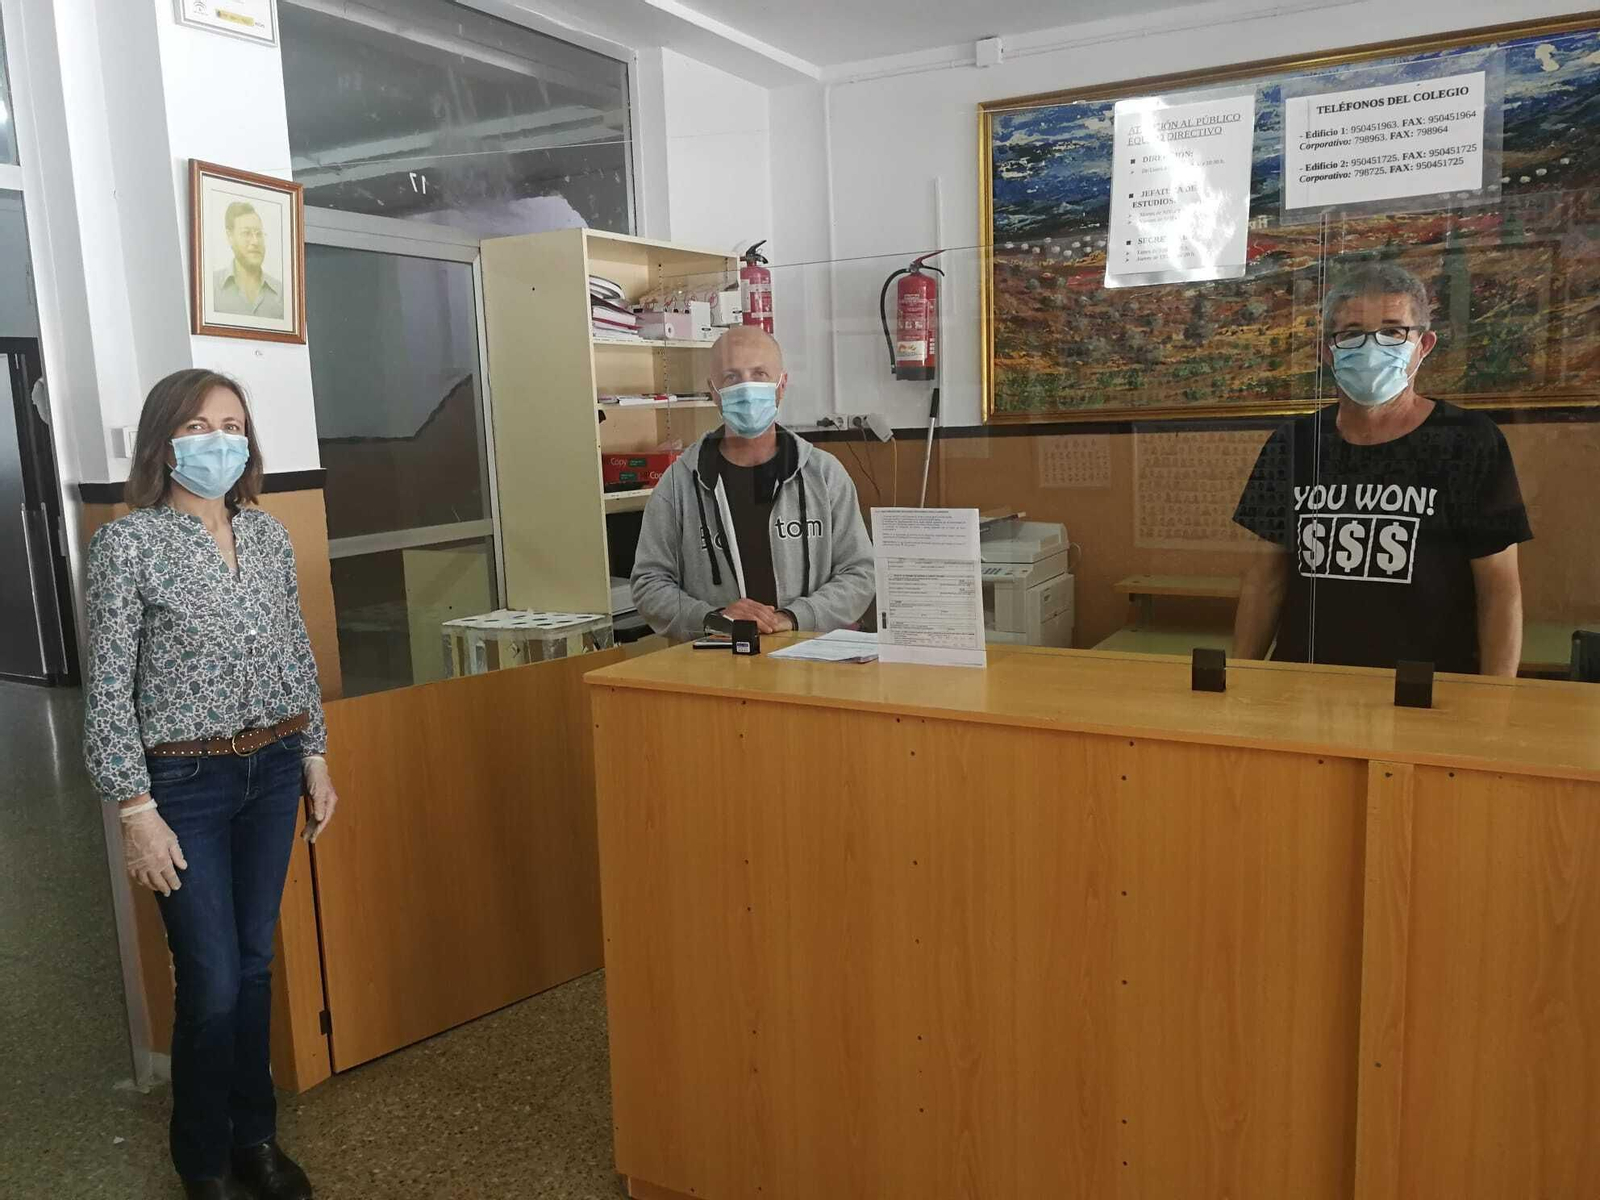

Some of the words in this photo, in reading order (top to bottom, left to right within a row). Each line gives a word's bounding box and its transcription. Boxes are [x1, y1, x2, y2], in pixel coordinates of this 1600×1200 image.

[1316, 98, 1385, 114] TELÉFONOS
[1387, 94, 1411, 106] DEL
[1413, 86, 1469, 102] COLEGIO
[1167, 126, 1222, 141] DIRECTIVO
[1180, 119, 1195, 130] AL
[1196, 113, 1242, 126] PÚBLICO
[1305, 128, 1339, 139] Edificio
[1350, 121, 1400, 134] 950451963.
[1402, 117, 1426, 127] FAX:
[1428, 110, 1477, 124] 950451964
[1299, 138, 1352, 151] Corporativo:
[1354, 132, 1388, 144] 798963.
[1390, 130, 1414, 140] FAX:
[1416, 126, 1448, 137] 798964
[1299, 171, 1352, 184] Corporativo:
[1354, 166, 1388, 177] 798725.
[1389, 163, 1414, 174] FAX:
[1415, 157, 1465, 170] 950451725
[1305, 161, 1338, 172] Edificio
[1340, 160, 1349, 168] 2:
[1350, 154, 1400, 167] 950451725.
[1402, 150, 1427, 161] FAX:
[1428, 143, 1478, 157] 950451725
[610, 457, 627, 468] Copy
[1294, 484, 1348, 511] YOU
[1355, 484, 1438, 516] WON!
[774, 517, 822, 538] tom
